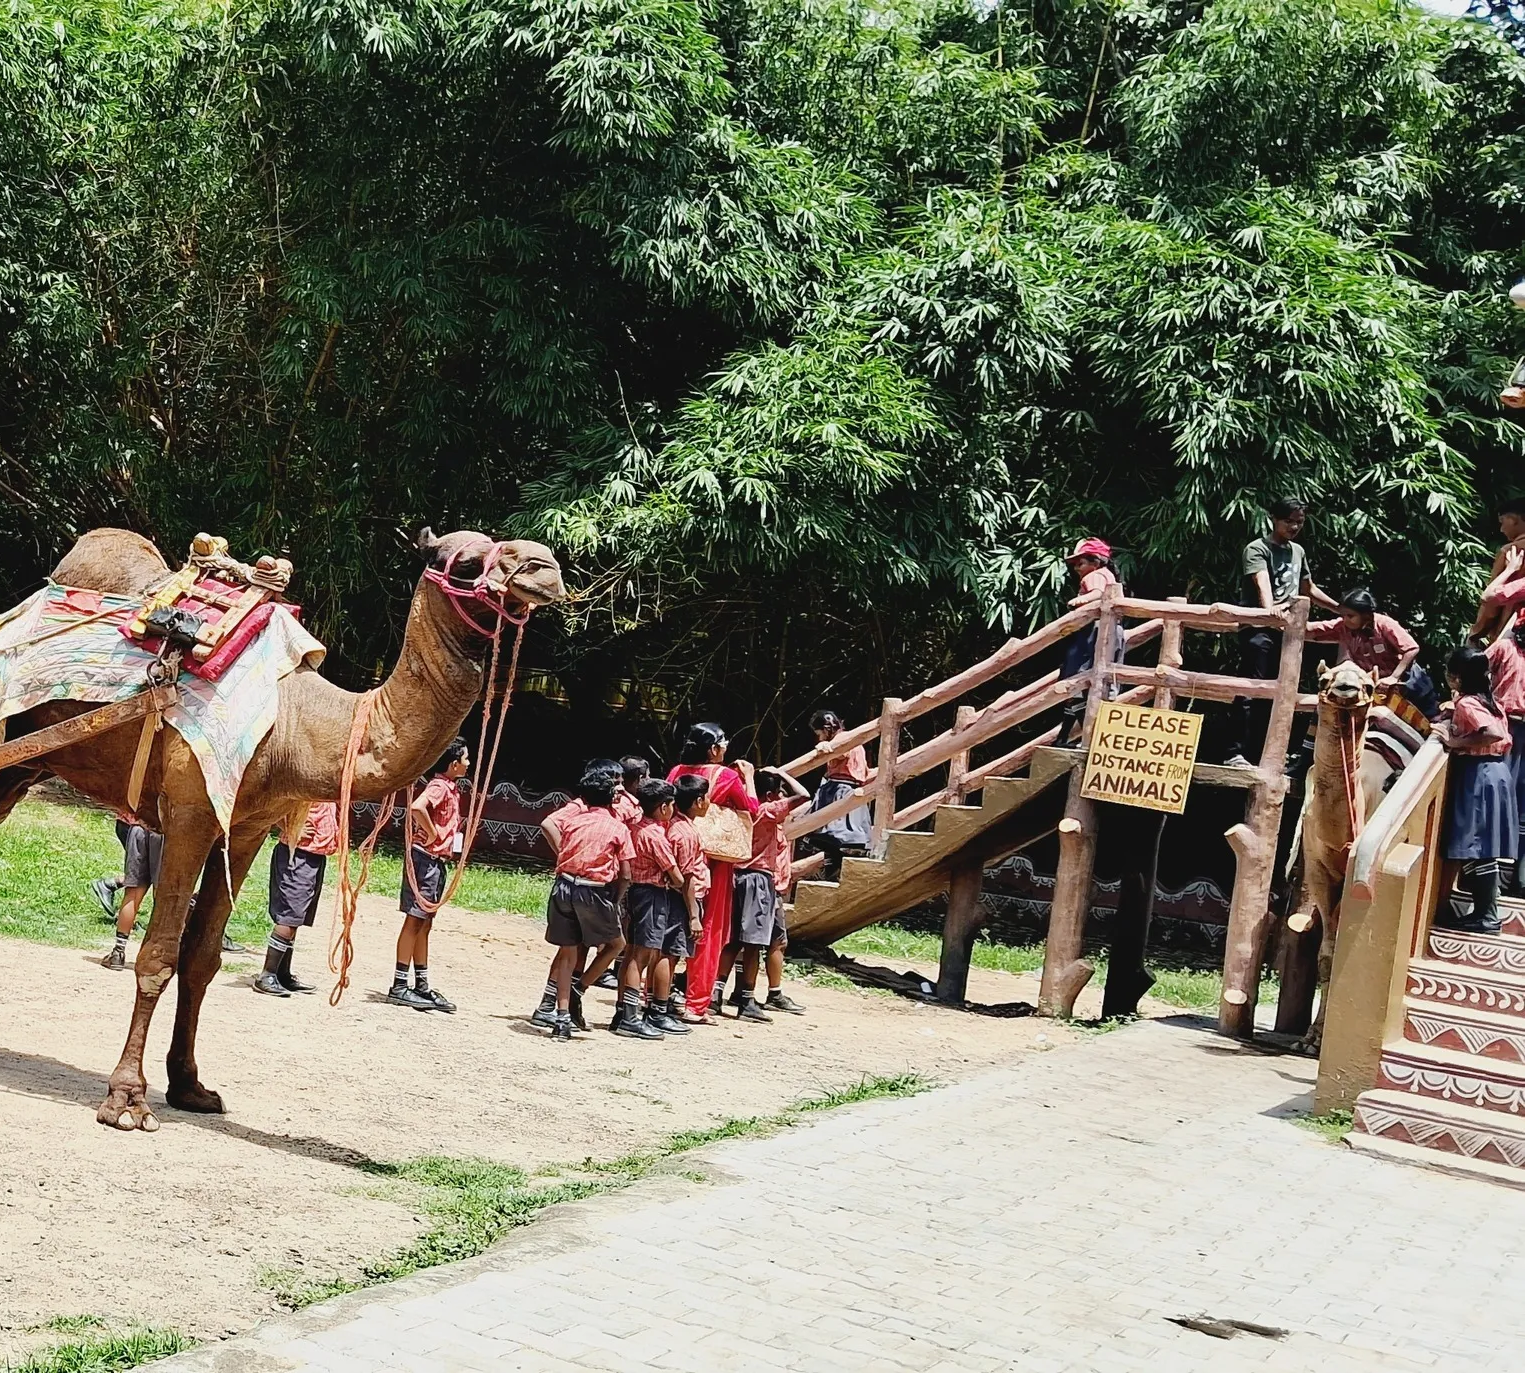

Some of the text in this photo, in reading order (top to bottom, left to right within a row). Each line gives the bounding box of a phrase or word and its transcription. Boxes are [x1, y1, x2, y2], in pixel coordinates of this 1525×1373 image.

[1108, 709, 1191, 736] PLEASE
[1099, 732, 1193, 760] KEEP SAFE
[1091, 752, 1190, 780] DISTANCE FROM
[1087, 771, 1183, 804] ANIMALS
